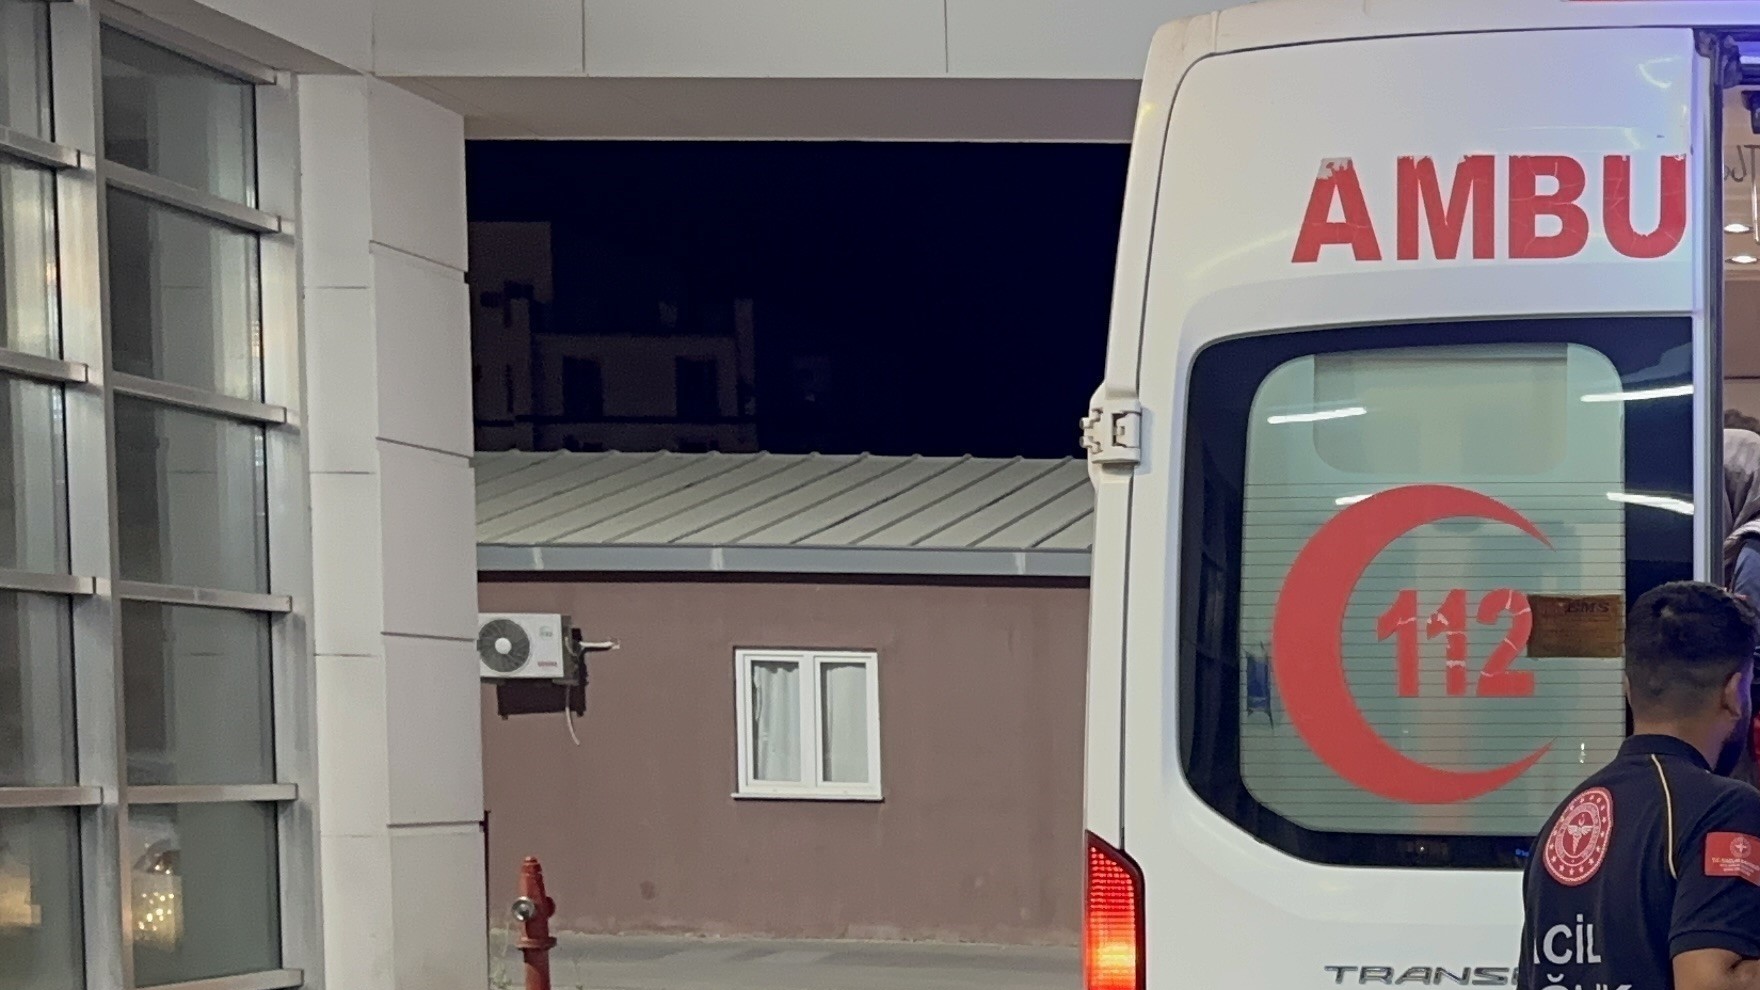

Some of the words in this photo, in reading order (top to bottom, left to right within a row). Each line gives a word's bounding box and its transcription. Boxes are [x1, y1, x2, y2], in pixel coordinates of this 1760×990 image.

[1291, 155, 1687, 263] AMBU
[1376, 588, 1535, 697] 112
[1533, 913, 1602, 965] CİL
